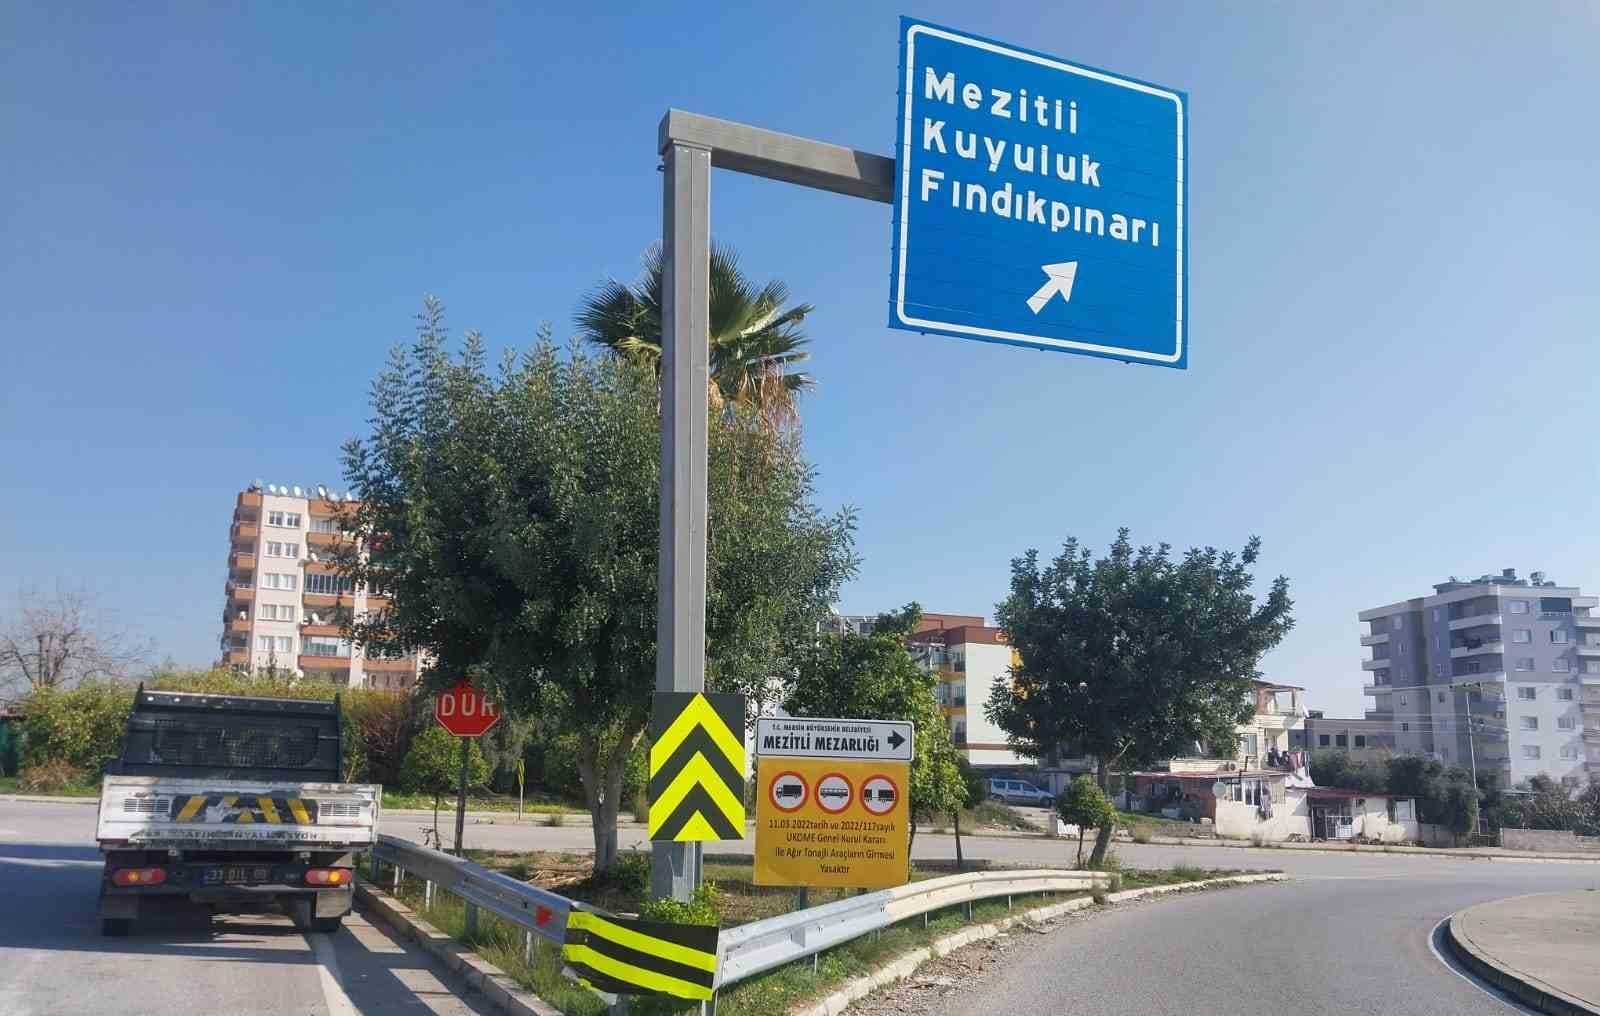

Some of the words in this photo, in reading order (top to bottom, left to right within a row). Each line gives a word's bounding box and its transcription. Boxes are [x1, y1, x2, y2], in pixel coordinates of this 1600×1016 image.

[925, 67, 1077, 134] Mezitli
[923, 118, 1100, 187] Kuyuluk
[921, 169, 1159, 246] Fındıkpınarı
[441, 693, 496, 717] DUR
[764, 732, 810, 750] MEZİTLİ
[815, 735, 879, 752] MEZARLIĞI
[830, 822, 839, 830] ve
[786, 832, 816, 842] UKOME
[818, 833, 839, 843] Genel
[786, 848, 801, 858] Ağır
[820, 863, 849, 873] Yasaktır
